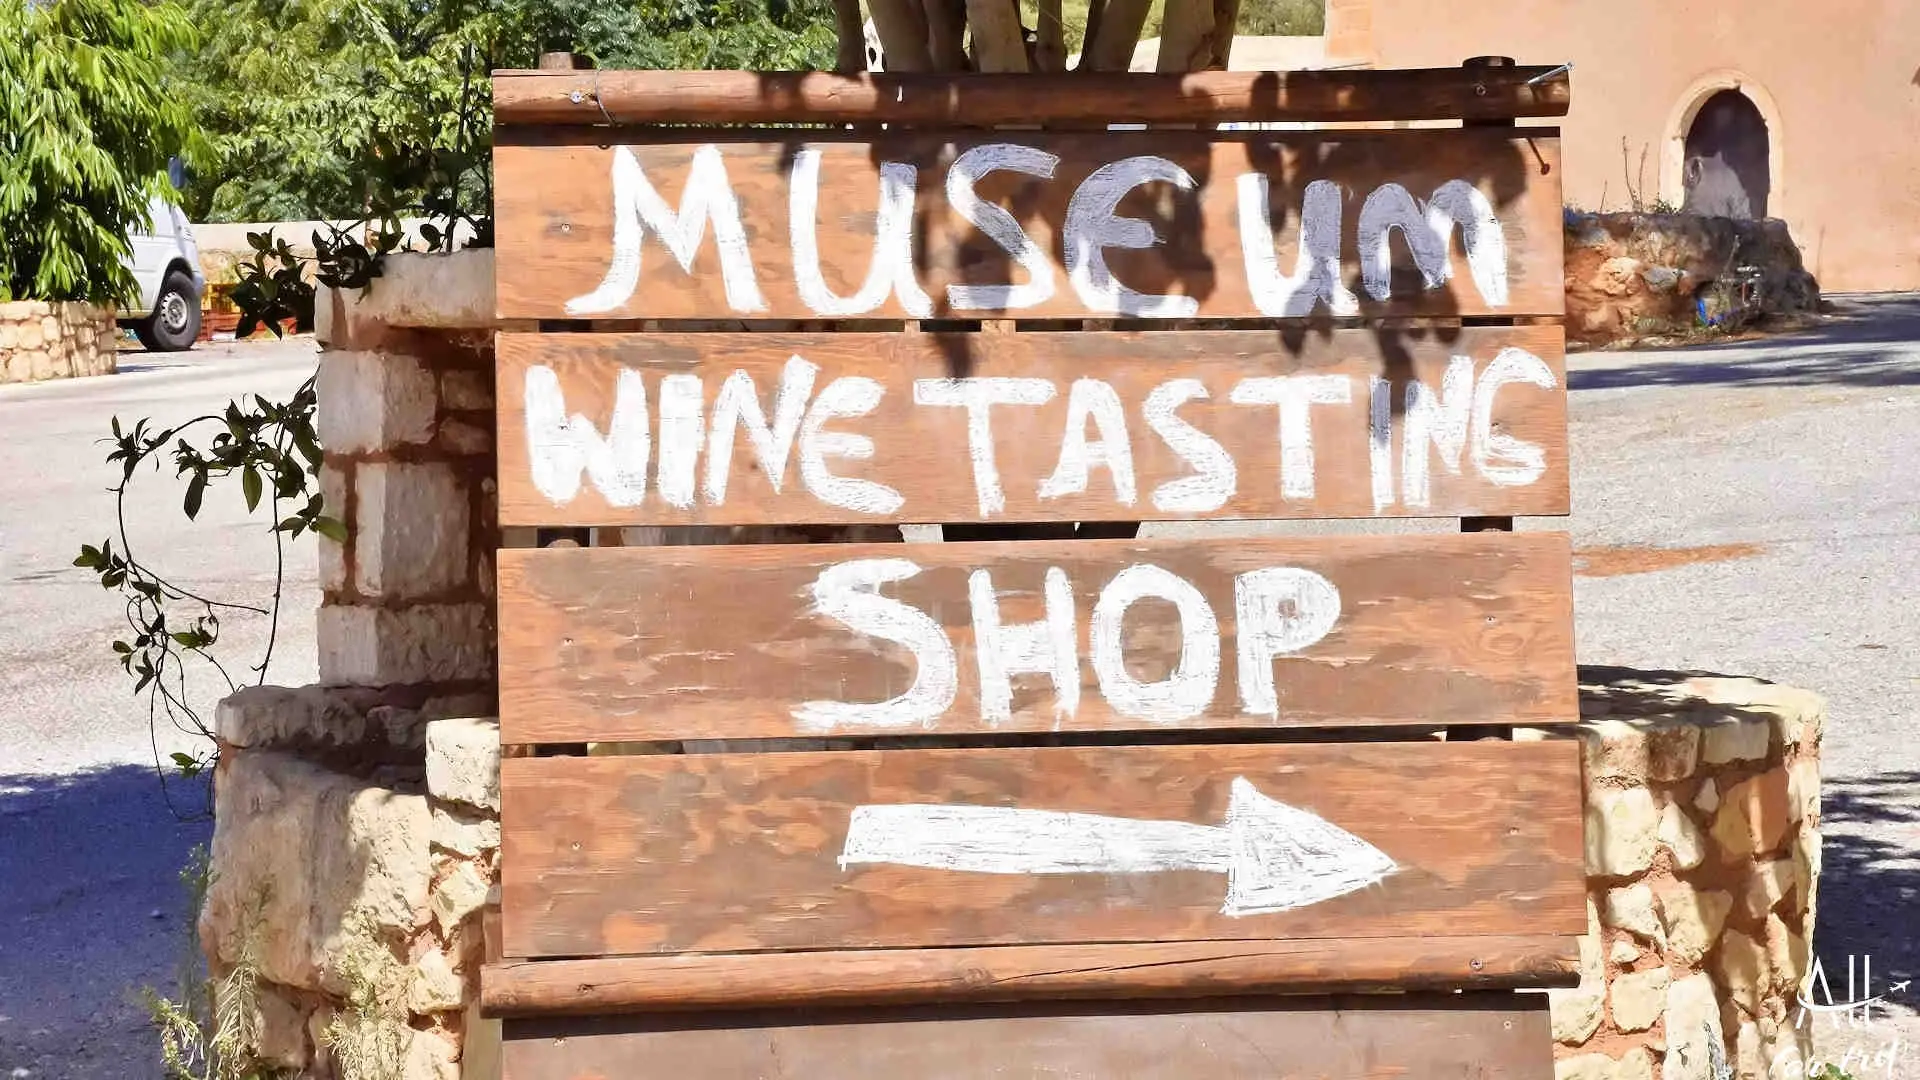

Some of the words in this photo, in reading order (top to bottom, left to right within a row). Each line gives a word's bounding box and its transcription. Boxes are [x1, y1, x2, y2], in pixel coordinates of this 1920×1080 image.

[565, 143, 1508, 318] MUSEUM
[524, 353, 906, 515] WINE
[912, 346, 1557, 517] TASTING
[790, 558, 1341, 730] SHOP
